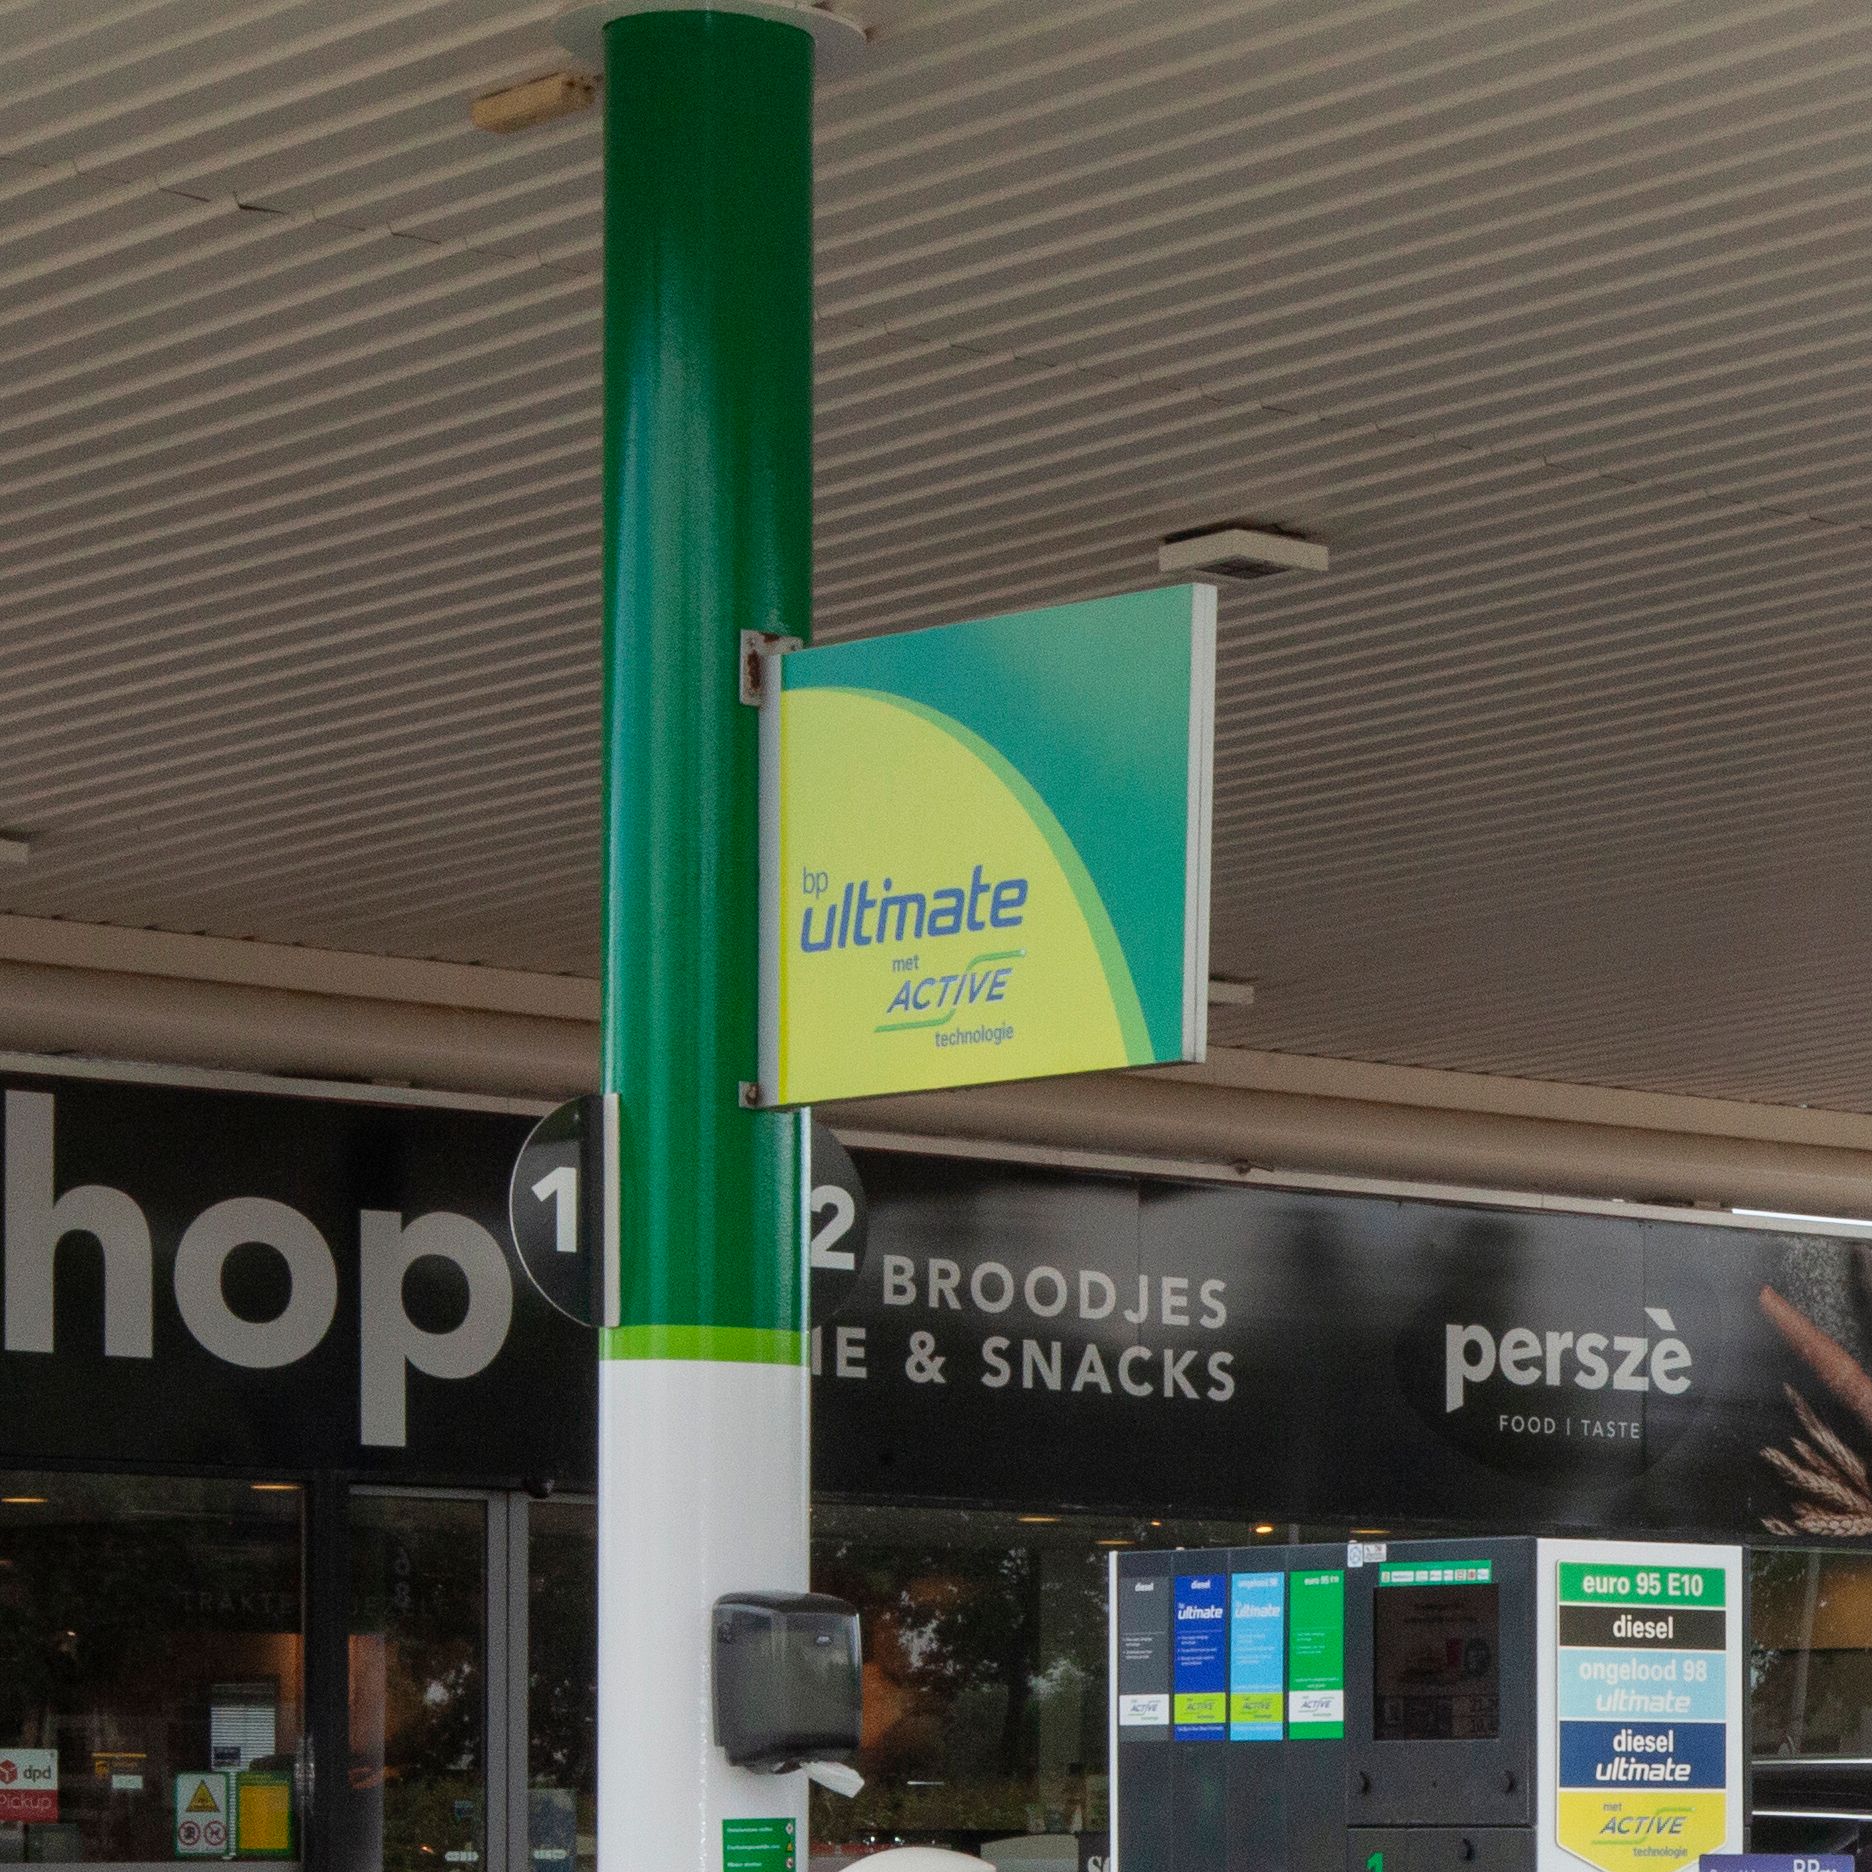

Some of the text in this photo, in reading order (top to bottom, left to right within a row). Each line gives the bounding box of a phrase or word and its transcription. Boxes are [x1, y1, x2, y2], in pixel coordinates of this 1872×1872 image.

[802, 866, 828, 899] bp
[800, 865, 1028, 953] ultimate
[892, 954, 920, 974] met
[886, 968, 1013, 1014] ACTIVE
[935, 1022, 1014, 1048] technologie
[532, 1167, 578, 1253] 1
[810, 1184, 856, 1271] 2
[4, 1090, 513, 1447] hop
[883, 1254, 1229, 1330] BROODJES
[905, 1330, 946, 1385] &
[981, 1336, 1236, 1402] SNACKS
[1446, 1307, 1692, 1414] perszè
[1499, 1414, 1641, 1440] FOOD TASTE
[1583, 1572, 1704, 1598] euro 95 E10
[1178, 1604, 1223, 1621] ultimate
[1613, 1614, 1674, 1640] diesel
[1579, 1659, 1708, 1686] ongelood 98
[1596, 1690, 1691, 1714] ultimate
[1613, 1729, 1674, 1754] diesel
[23, 1764, 52, 1782] dpd
[1596, 1757, 1691, 1782] ultimate
[1600, 1815, 1687, 1835] ACTIVE
